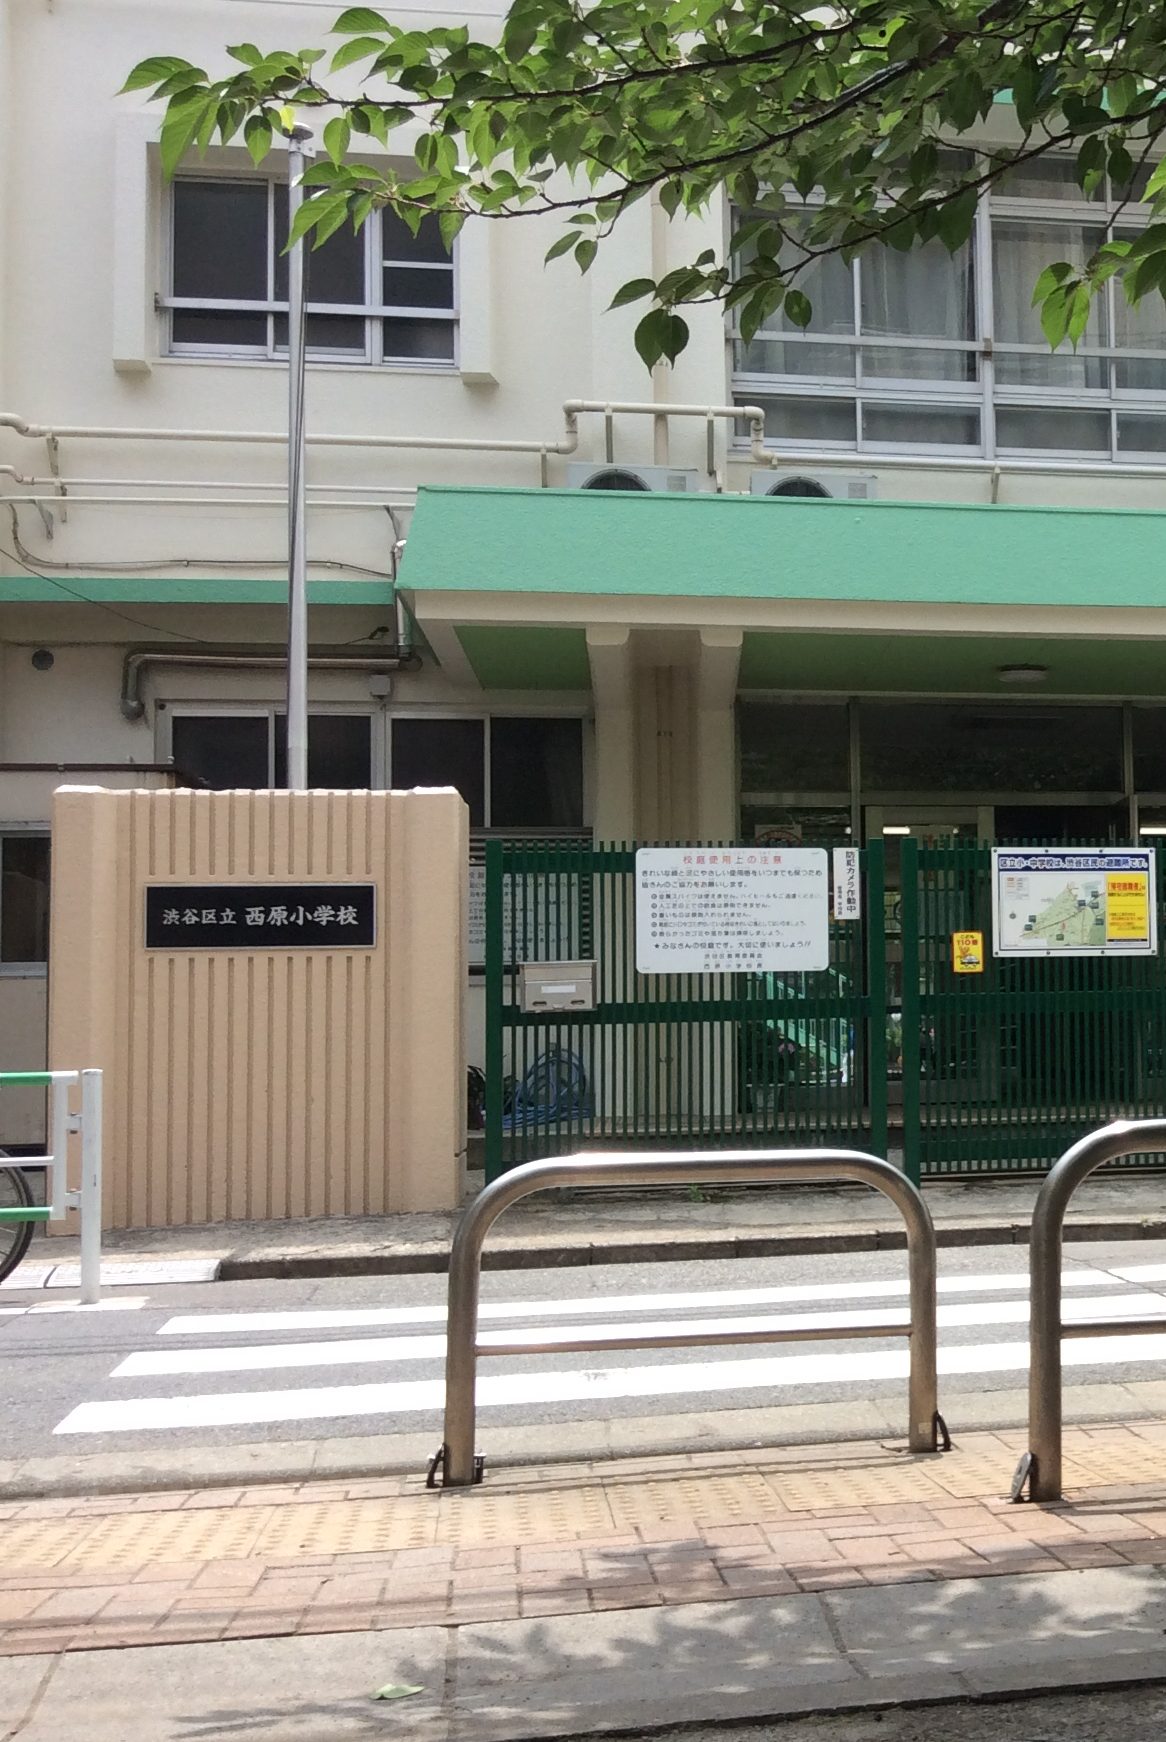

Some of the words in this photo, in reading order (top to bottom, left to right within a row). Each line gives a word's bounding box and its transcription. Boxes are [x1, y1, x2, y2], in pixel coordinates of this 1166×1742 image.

[682, 855, 783, 865] 校庭使用上の注意
[845, 850, 857, 913] 防犯カメラ作動中
[162, 908, 238, 926] 渋谷区立
[244, 905, 359, 927] 西原小学校
